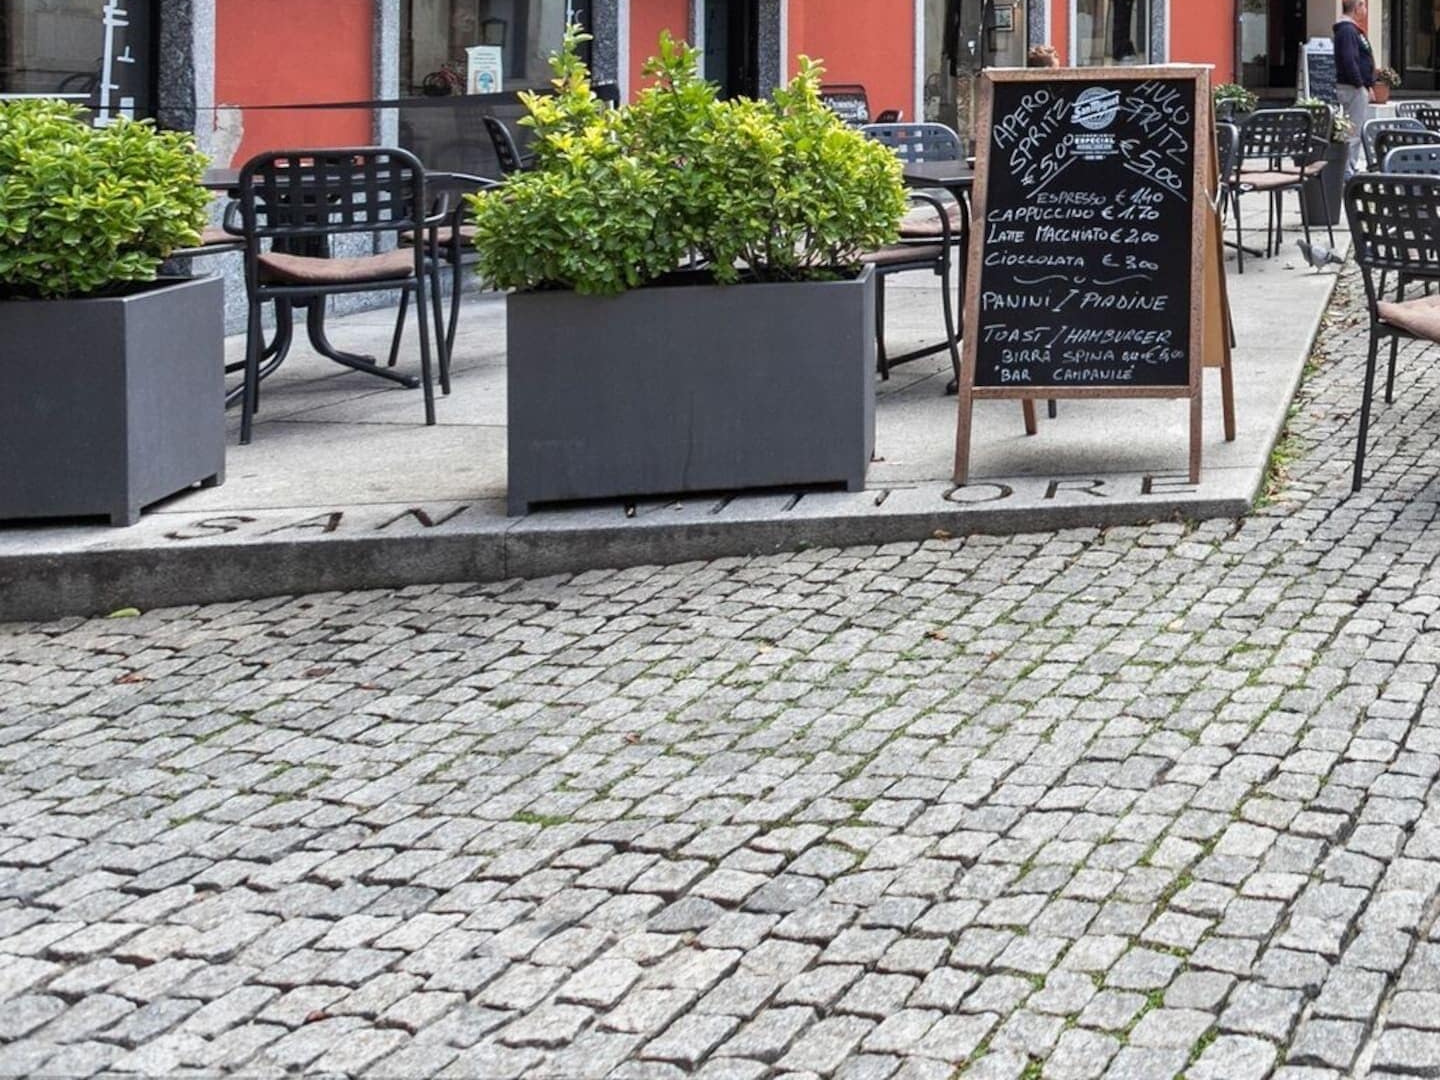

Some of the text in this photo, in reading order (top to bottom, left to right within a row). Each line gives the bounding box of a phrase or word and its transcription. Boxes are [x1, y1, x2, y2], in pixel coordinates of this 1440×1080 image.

[1133, 80, 1190, 125] HUGO
[993, 87, 1055, 150] APERO
[1009, 97, 1074, 175] SPRITZ
[1119, 96, 1189, 166] SPRITZ
[1036, 191, 1107, 206] ESPRESSO
[987, 205, 1095, 222] CAPPUCCINO
[987, 222, 1025, 244] LATTE
[1035, 225, 1109, 242] MACCHIATO
[982, 289, 1052, 311] PANINI
[1080, 291, 1169, 311] PIADINE
[983, 324, 1051, 343] TOAST
[1063, 328, 1173, 345] HAMBURGER
[1001, 348, 1051, 364] BIRRA
[1062, 349, 1115, 364] SPINA
[162, 504, 472, 541] SAN
